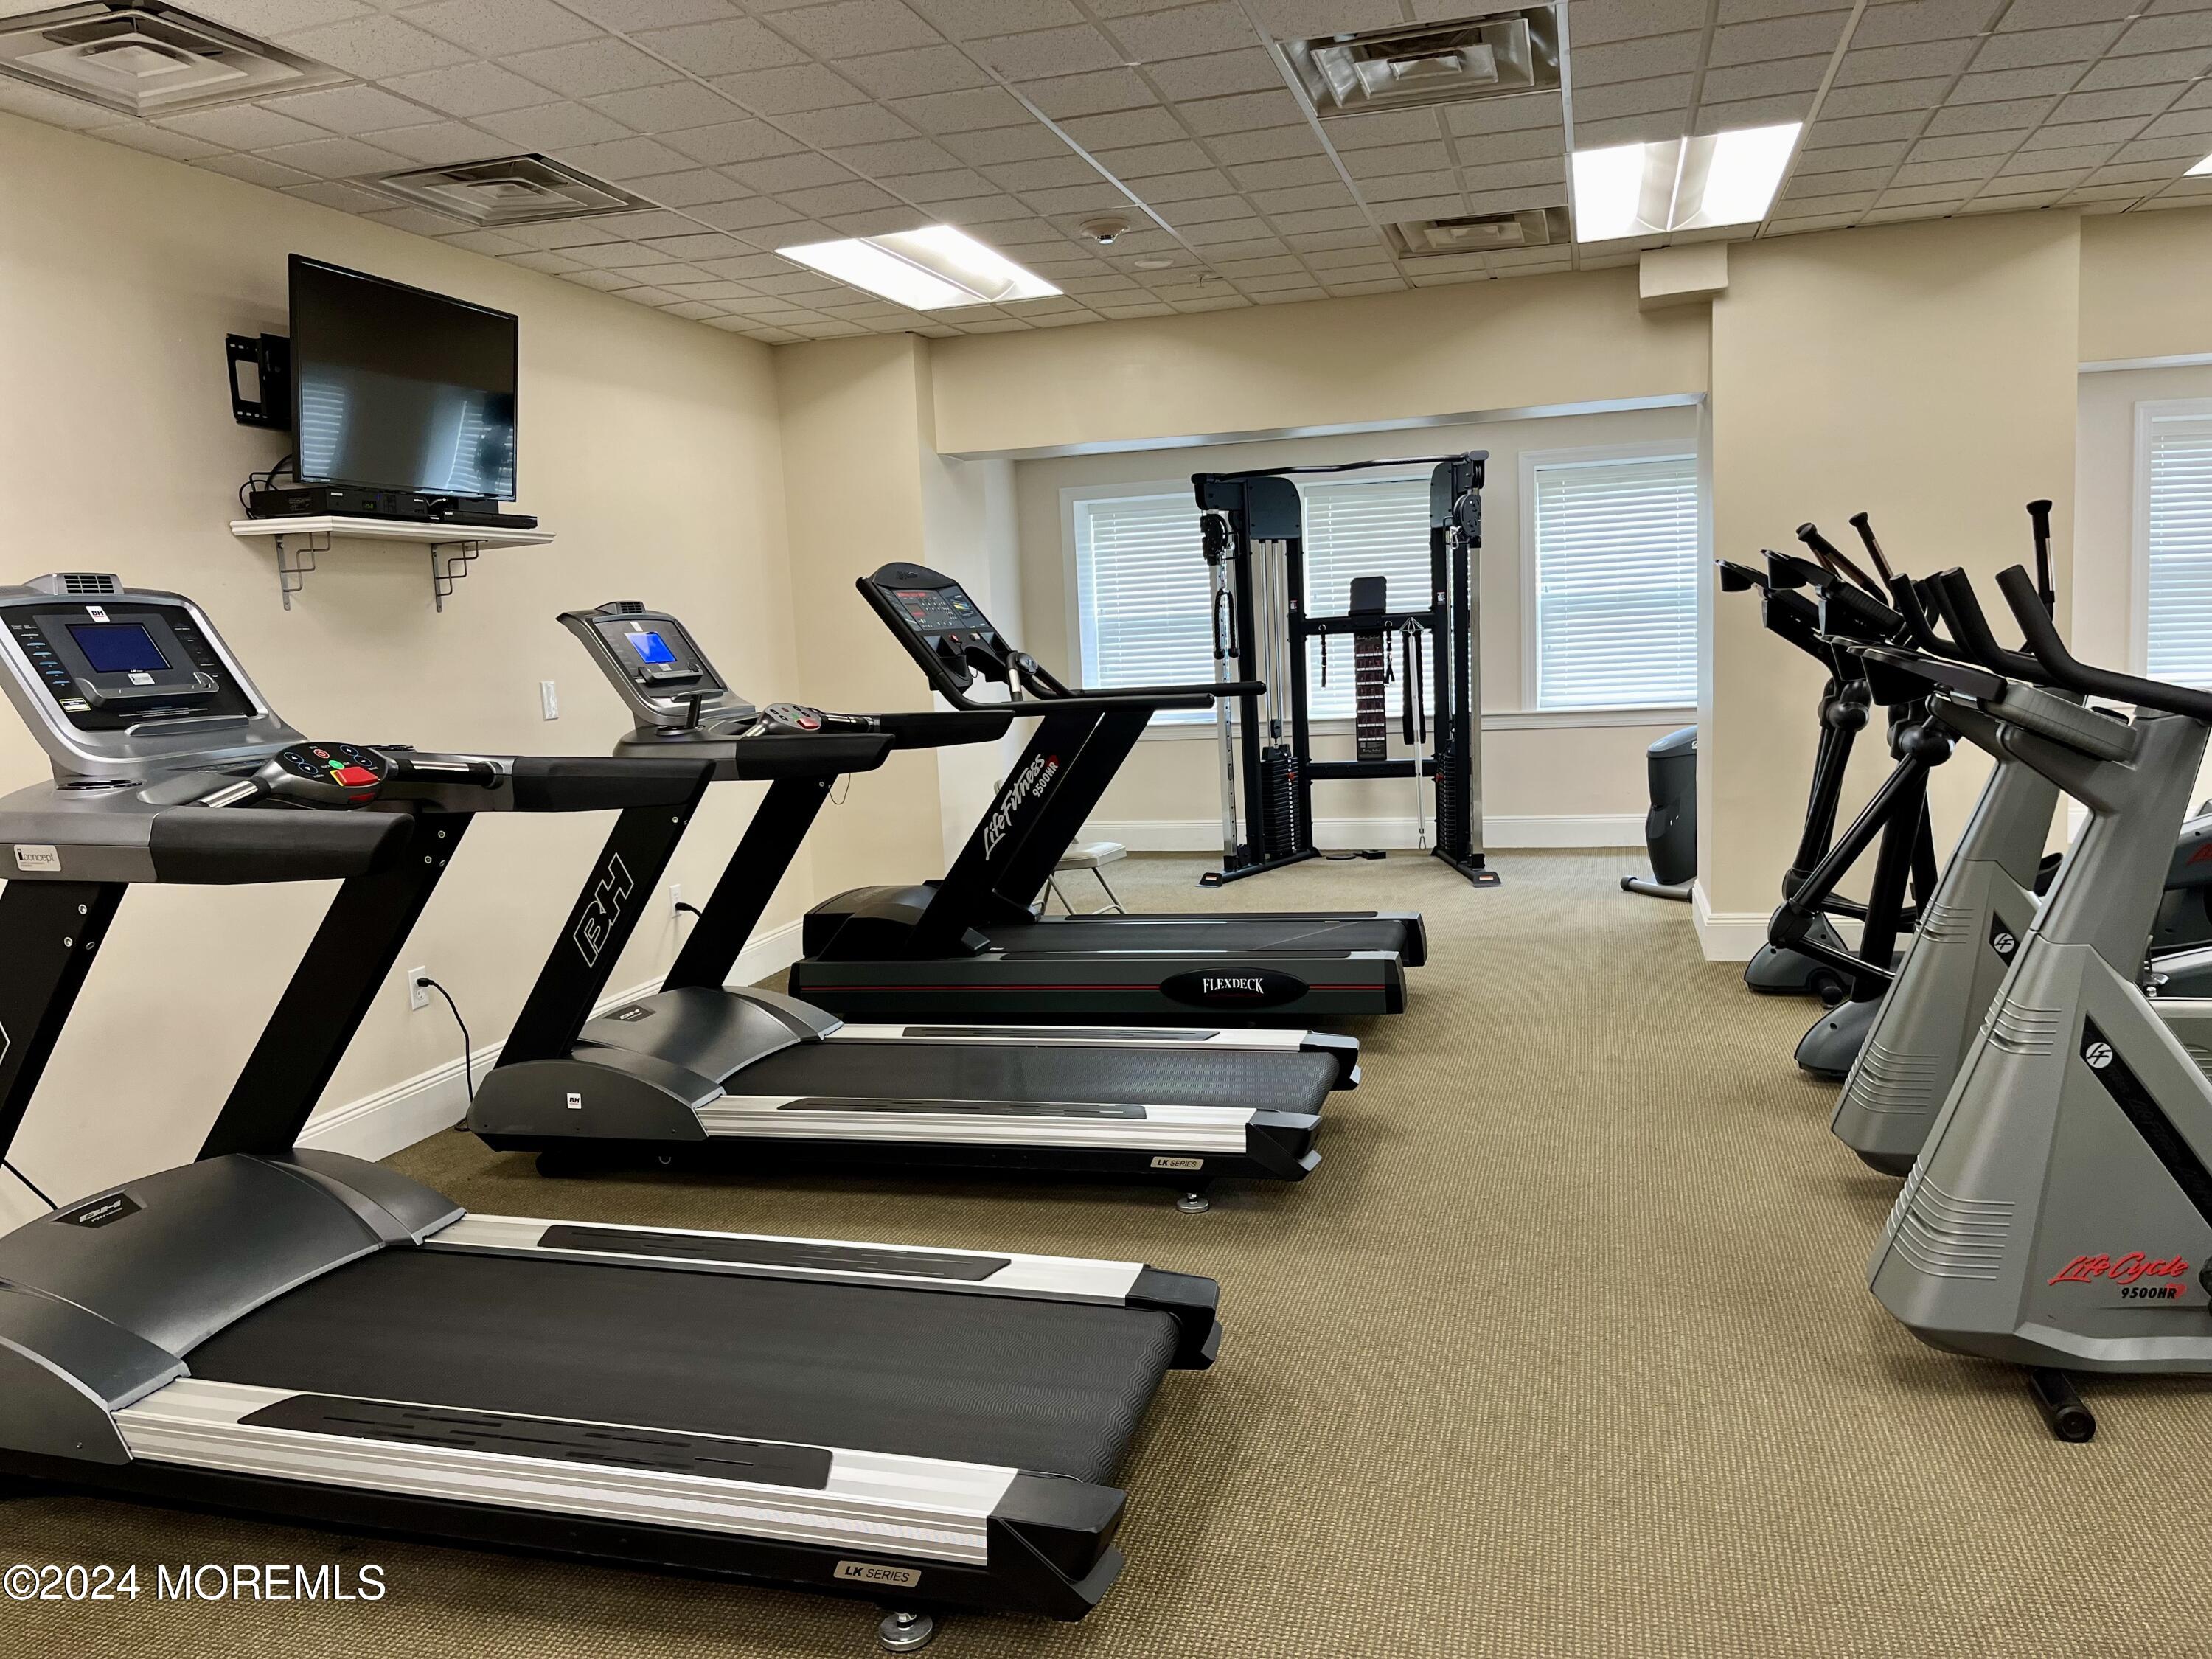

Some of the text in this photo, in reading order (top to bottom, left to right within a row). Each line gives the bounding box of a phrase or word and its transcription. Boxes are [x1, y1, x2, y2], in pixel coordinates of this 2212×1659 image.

[1032, 761, 1059, 797] 9500HR
[573, 852, 634, 968] BH
[1203, 978, 1265, 995] FLEXDECK
[1169, 1160, 1197, 1168] SERIES
[2121, 1287, 2178, 1300] 9500HR
[844, 1565, 911, 1582] LK SERIES
